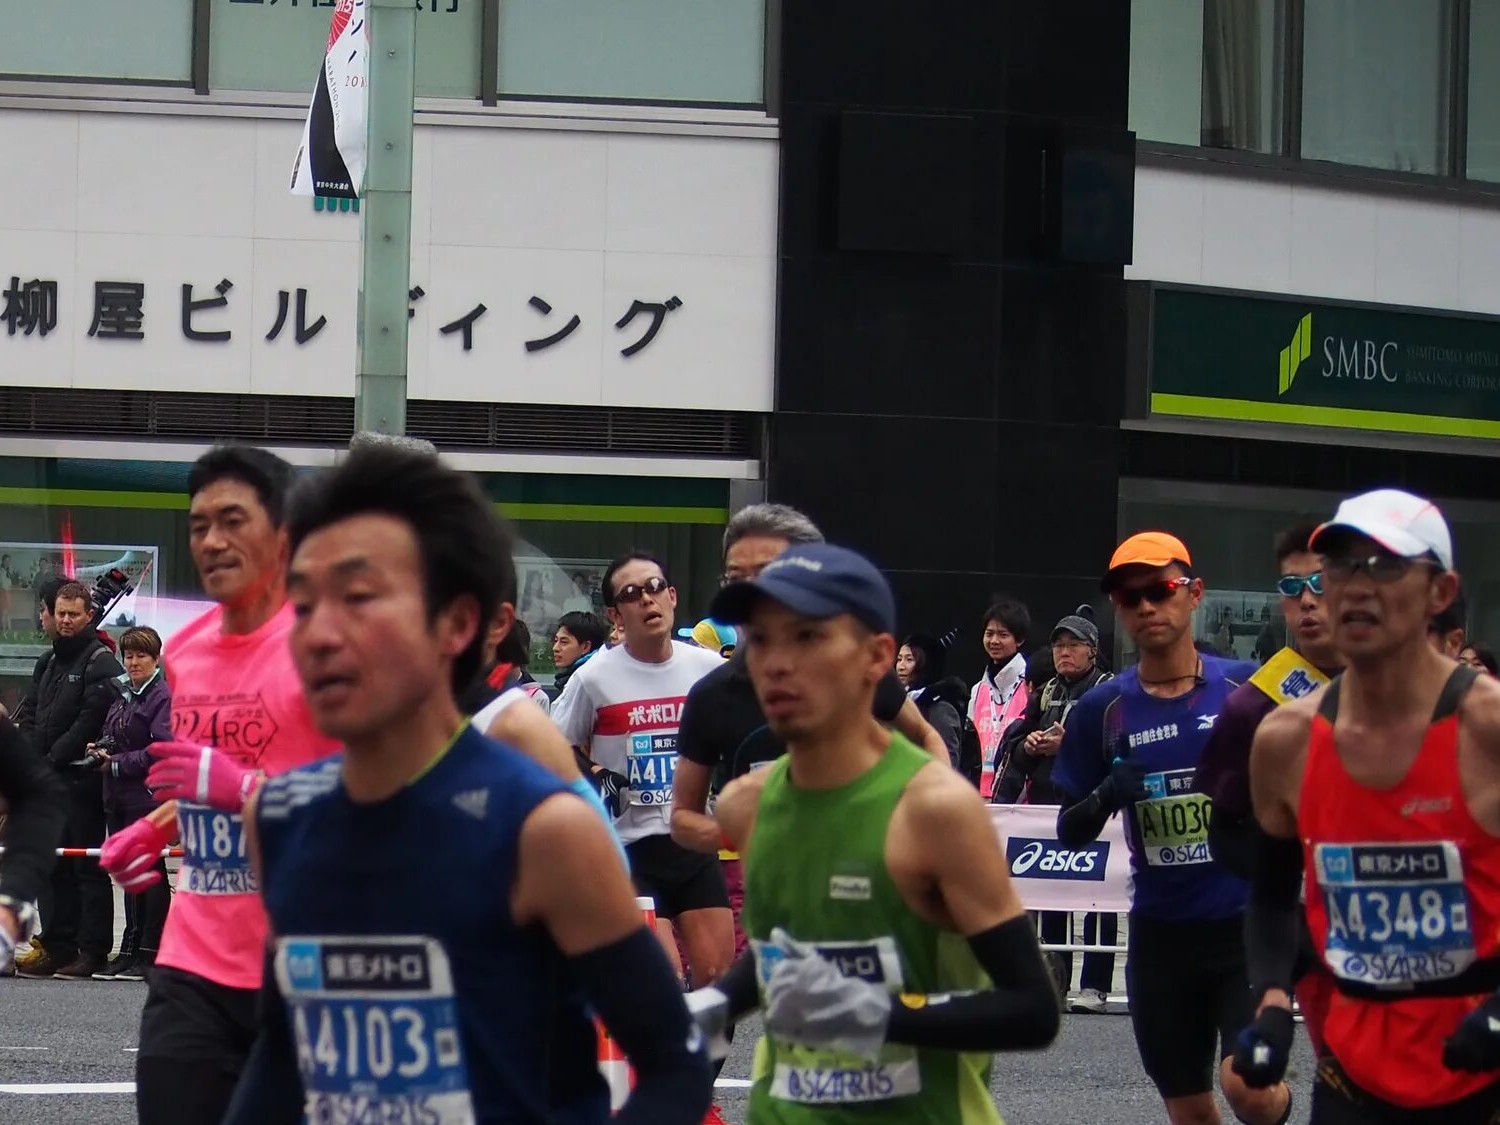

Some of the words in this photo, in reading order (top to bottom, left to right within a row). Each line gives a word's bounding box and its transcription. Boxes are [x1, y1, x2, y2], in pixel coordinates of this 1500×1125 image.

[0, 276, 683, 357] 柳屋ビルィング
[1322, 336, 1398, 382] SMBC
[1039, 849, 1098, 872] asics
[1358, 855, 1441, 873] 東京メトロ
[1329, 889, 1446, 941] A4348
[327, 953, 422, 981] 東京メトロ
